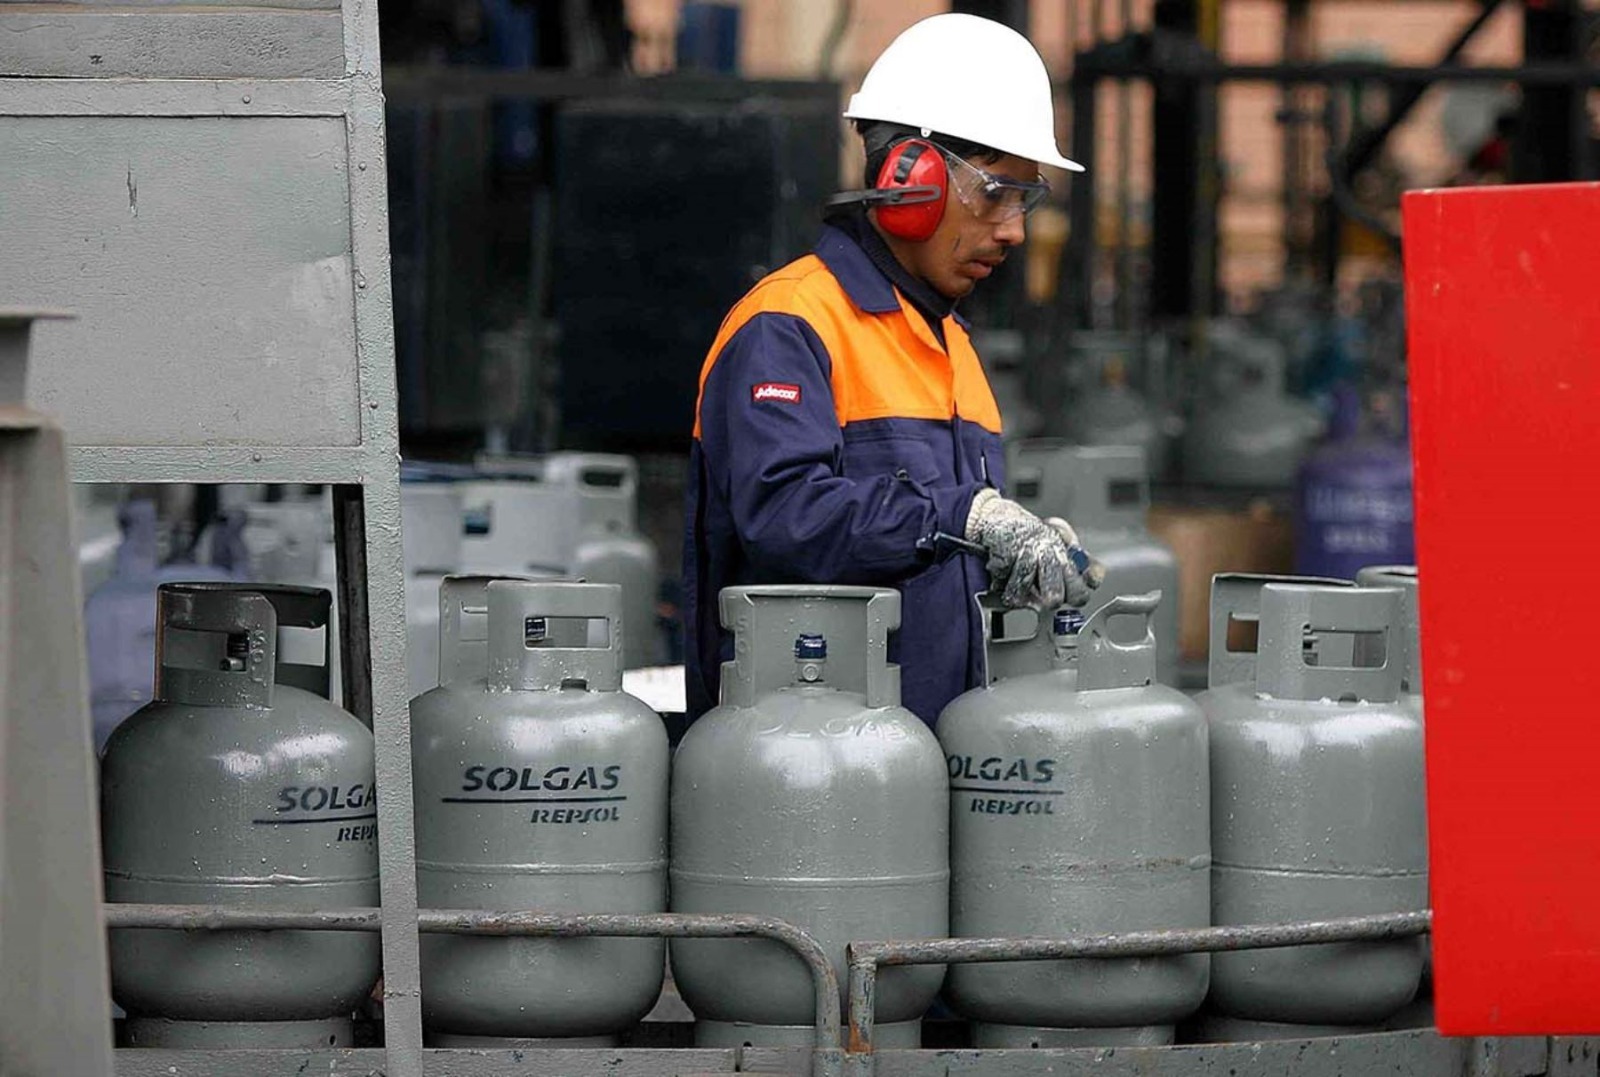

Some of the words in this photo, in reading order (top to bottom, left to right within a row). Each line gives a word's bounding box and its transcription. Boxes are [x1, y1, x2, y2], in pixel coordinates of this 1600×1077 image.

[462, 765, 621, 792] SOLGAS
[948, 754, 1057, 783] OLGAS
[277, 782, 376, 812] SOLGA
[970, 798, 1054, 815] REPSOL
[530, 806, 620, 824] REPSOL
[337, 824, 377, 842] REPS
